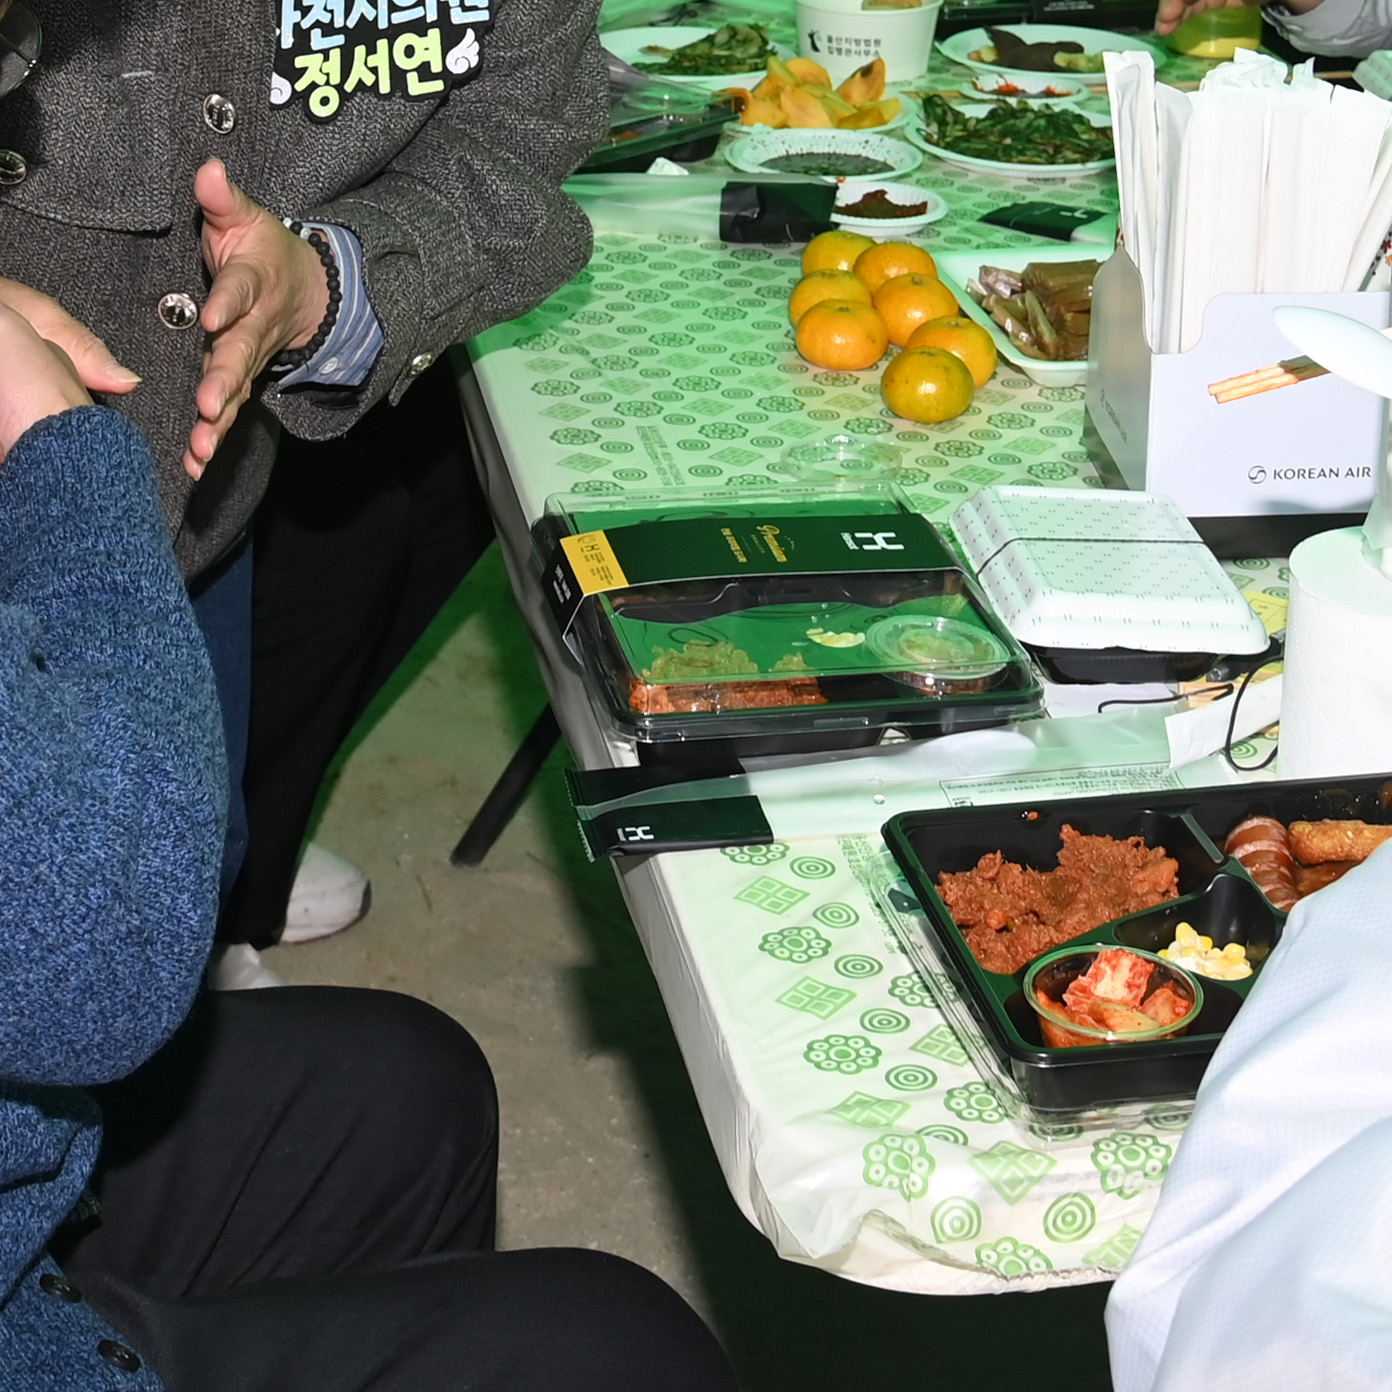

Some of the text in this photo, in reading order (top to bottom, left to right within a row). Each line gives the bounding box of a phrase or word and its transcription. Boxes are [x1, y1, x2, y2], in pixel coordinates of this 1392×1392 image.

[294, 27, 445, 118] 정서연
[1273, 466, 1372, 480] KOREAN AIR
